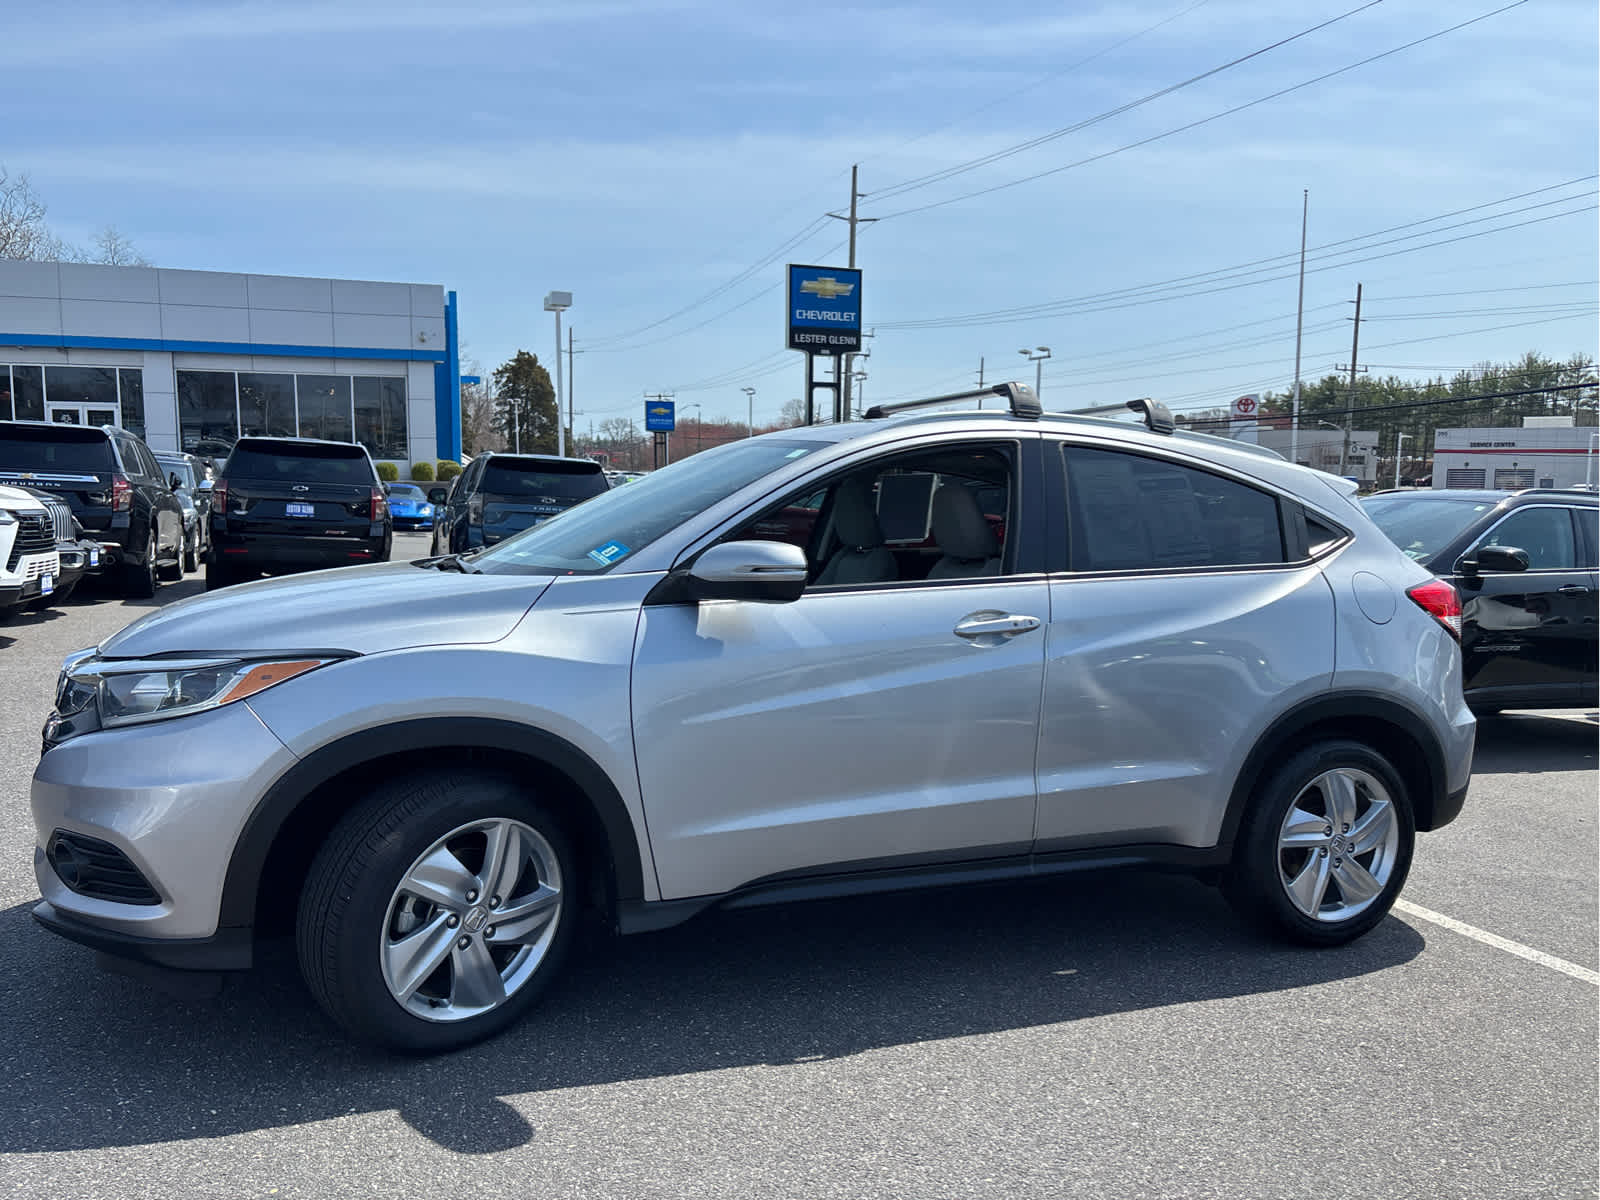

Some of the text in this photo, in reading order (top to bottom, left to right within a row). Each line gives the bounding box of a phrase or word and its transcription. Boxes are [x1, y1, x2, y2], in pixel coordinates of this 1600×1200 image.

[795, 309, 857, 322] CHEVROLET
[794, 333, 857, 345] LESTER GLENN
